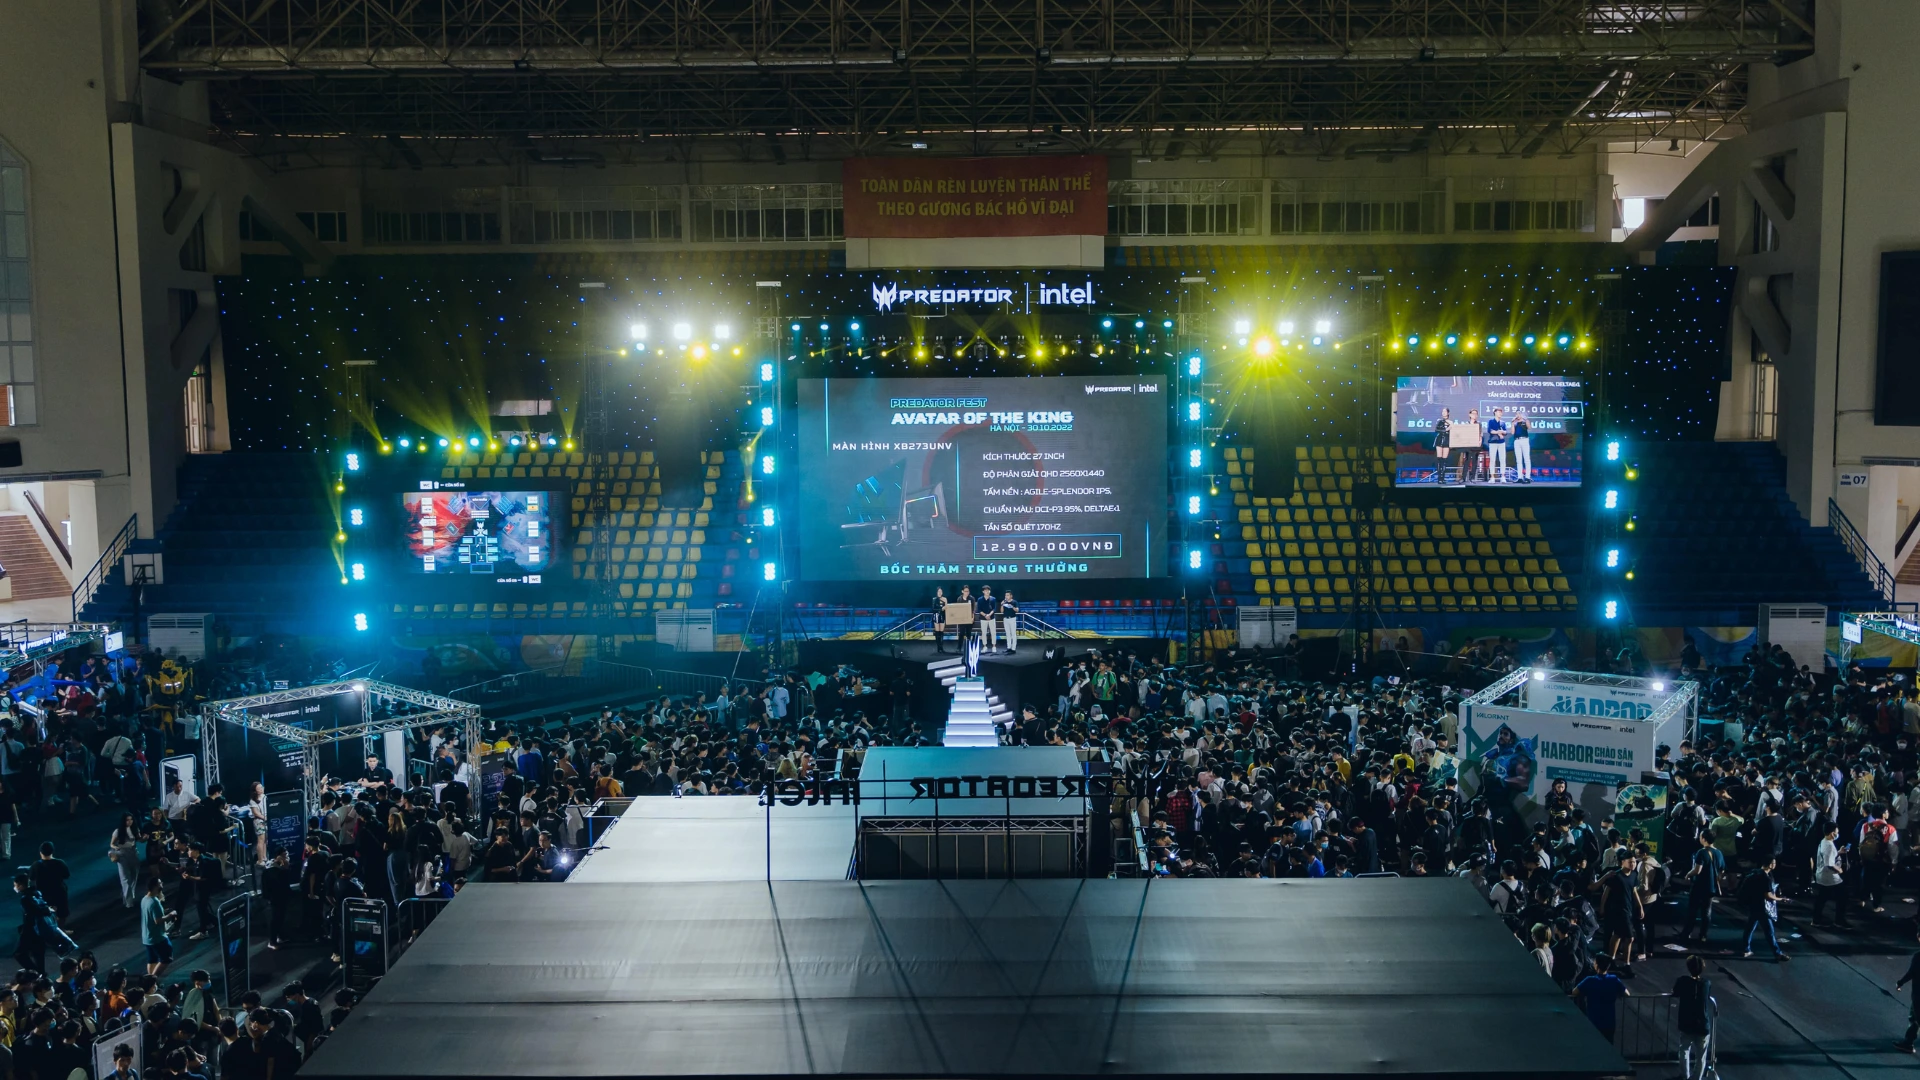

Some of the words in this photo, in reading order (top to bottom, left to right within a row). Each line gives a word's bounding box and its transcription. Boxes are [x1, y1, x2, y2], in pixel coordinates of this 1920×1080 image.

[860, 177, 899, 193] TOÀN
[903, 177, 932, 193] DÂN
[937, 176, 966, 193] RÈN
[970, 177, 1016, 197] LUYỆN
[1020, 176, 1059, 192] THÂN
[1063, 172, 1093, 191] THỂ
[877, 201, 915, 216] THEO
[919, 200, 971, 216] GƯƠNG
[975, 198, 1003, 216] BÁC
[1006, 197, 1028, 215] HỒ
[1031, 197, 1046, 215] VĨ
[1049, 199, 1074, 218] ĐẠI
[899, 289, 1013, 305] PREDATOR
[1040, 281, 1096, 305] intel
[1138, 383, 1159, 393] intel
[890, 398, 956, 408] PREDATOR
[957, 397, 987, 408] FEST
[891, 412, 961, 425] AVATAR
[963, 412, 988, 425] OF
[990, 411, 1024, 425] THE
[1027, 411, 1074, 424] KING
[1408, 418, 1432, 428] BỐC
[990, 423, 1002, 432] HÀ
[1003, 424, 1020, 433] NỘI
[1027, 424, 1072, 432] 30.10.2022
[832, 441, 857, 451] MÀN
[861, 441, 890, 451] HÌNH
[893, 442, 952, 451] XB273UNV
[982, 452, 1003, 461] KÍCH
[1003, 452, 1031, 461] THƯỚC
[1044, 452, 1065, 460] INCH
[983, 469, 996, 479] ĐỘ
[996, 469, 1020, 478] PHÂN
[1021, 469, 1039, 478] GIẢI
[1040, 470, 1059, 478] QHD
[1059, 469, 1105, 477] 2560X1440
[1853, 475, 1867, 485] 07
[983, 486, 1001, 496] TẤM
[1023, 487, 1095, 496] AGILE-SPLENDOR
[1035, 505, 1063, 513] DCI-P3
[1000, 522, 1013, 531] SỐ
[1014, 522, 1037, 531] QUÉT
[1036, 523, 1061, 531] 170HZ
[982, 541, 1113, 552] 12.990.000VNĐ
[880, 562, 910, 574] BỐC
[917, 562, 960, 574] THĂM
[966, 562, 1018, 574] TRÚNG
[1025, 561, 1088, 573] THƯỞNG
[269, 709, 300, 718] PREDATOR
[305, 704, 320, 714] intel
[1476, 712, 1509, 721] VALORANT
[1580, 723, 1611, 731] PREDATOR
[1619, 724, 1635, 734] intel
[1541, 741, 1594, 764] HARBOR
[1594, 746, 1616, 759] CHÀO
[1617, 747, 1633, 761] SÂN
